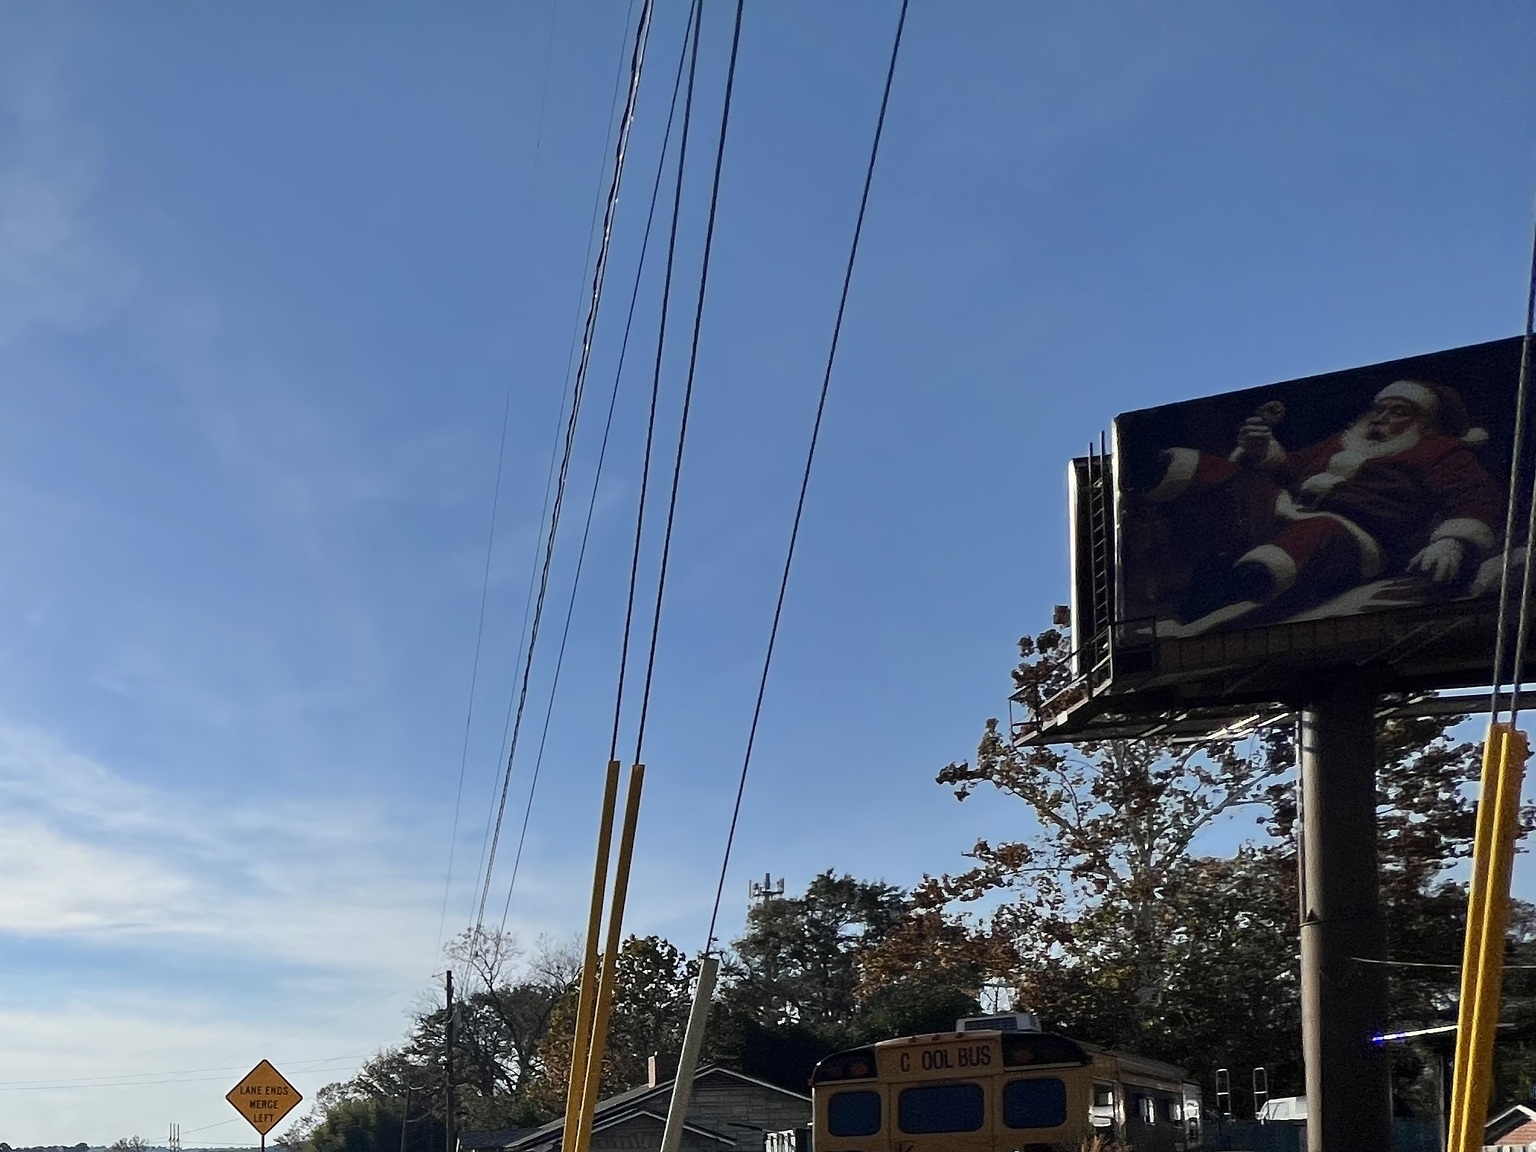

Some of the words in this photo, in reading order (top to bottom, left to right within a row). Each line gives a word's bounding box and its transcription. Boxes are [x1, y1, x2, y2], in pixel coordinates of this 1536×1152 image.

[958, 1045, 991, 1067] BUS
[240, 1086, 262, 1096] LANE
[265, 1086, 289, 1095] ENDS
[249, 1100, 278, 1109] MERGE
[253, 1114, 274, 1123] LEFT
